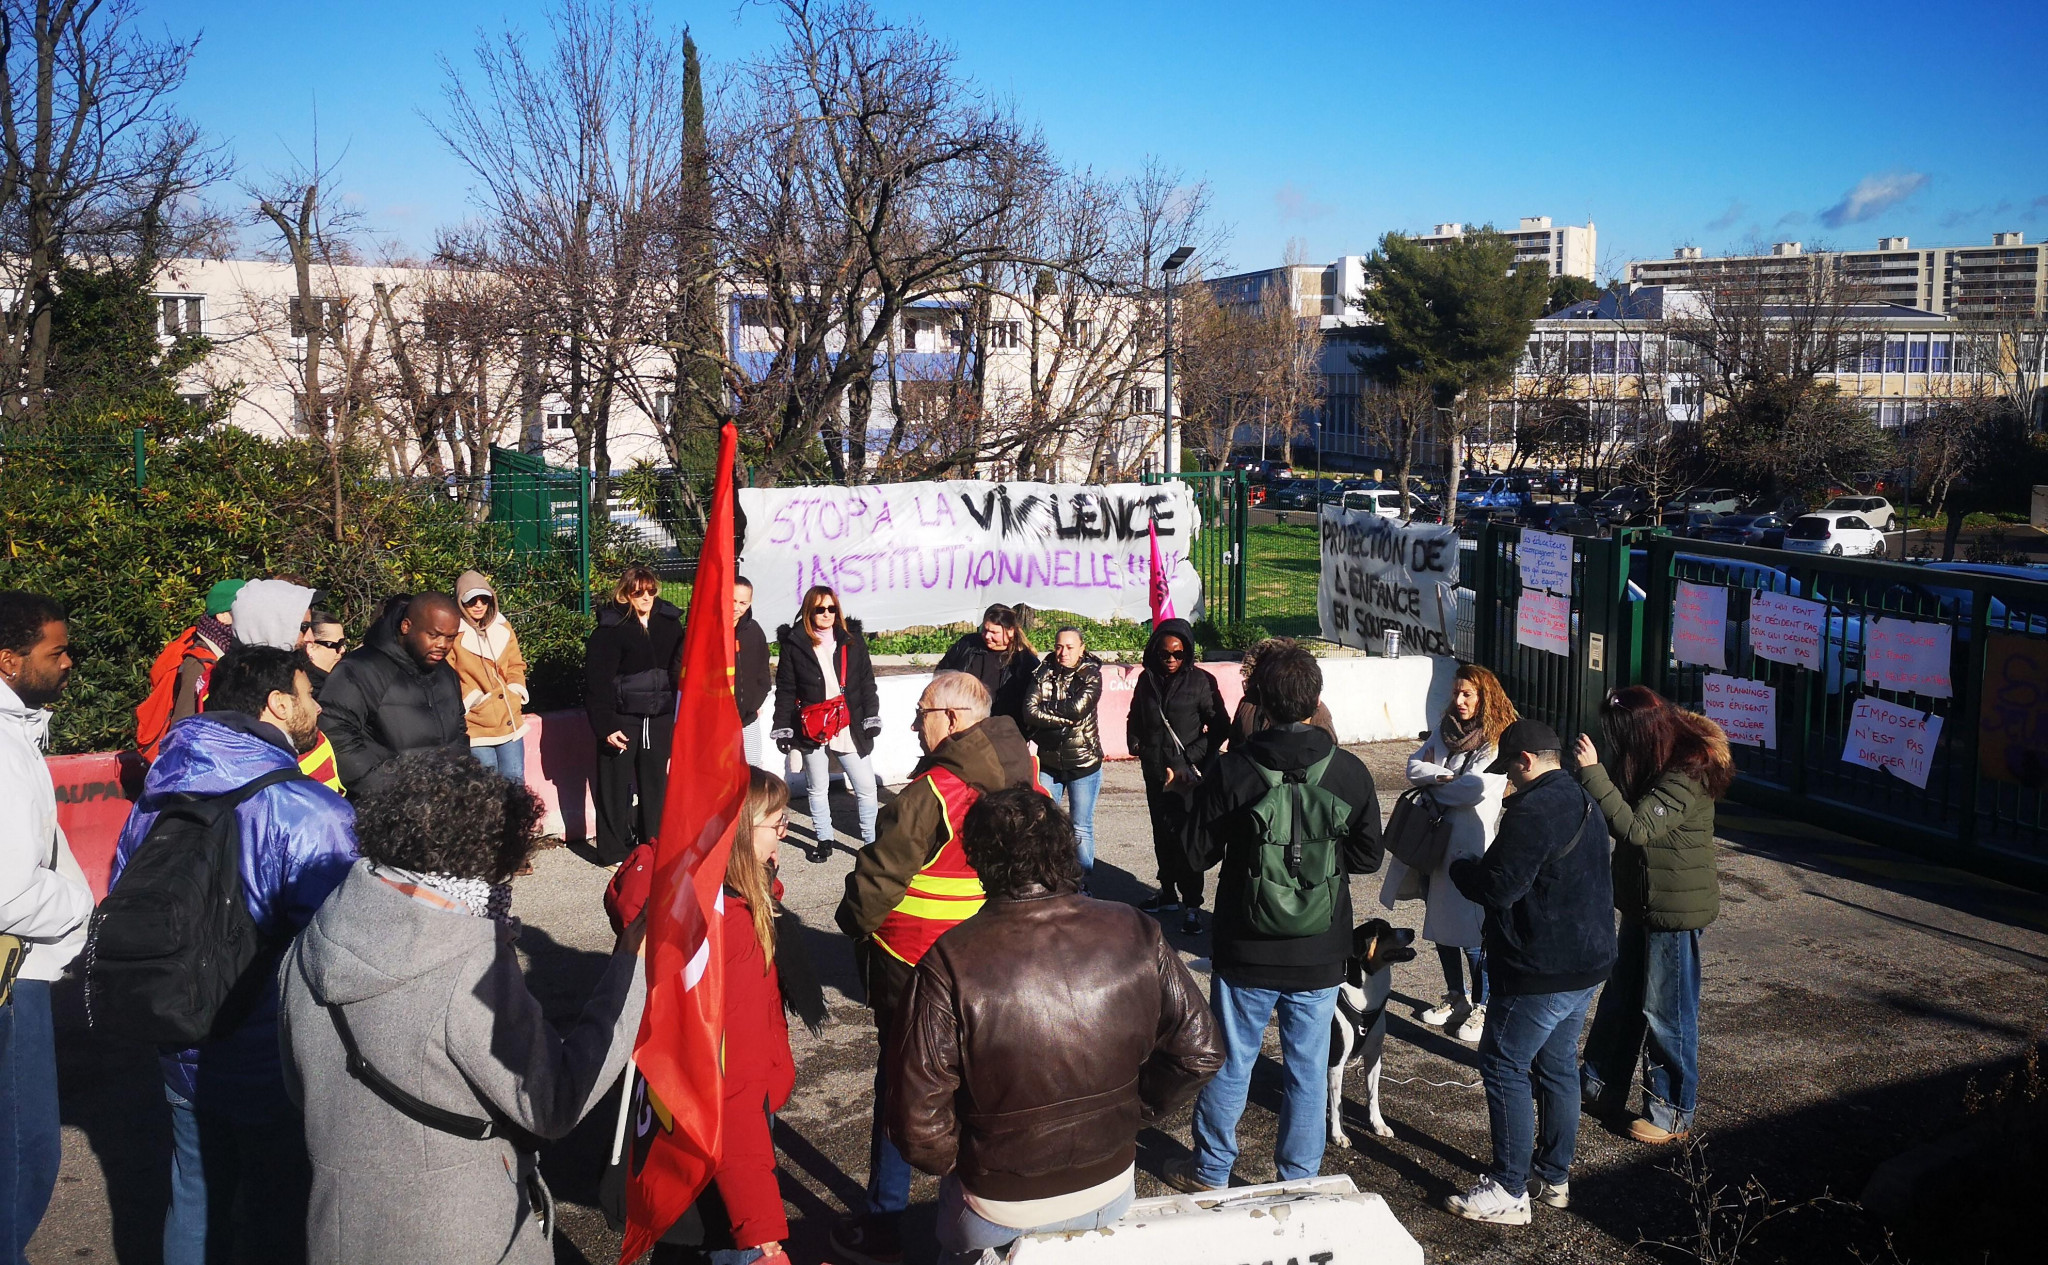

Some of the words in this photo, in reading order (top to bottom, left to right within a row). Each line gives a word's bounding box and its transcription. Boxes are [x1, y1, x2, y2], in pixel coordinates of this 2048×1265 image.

[771, 499, 867, 544] STOP
[914, 492, 956, 526] LA
[1322, 518, 1406, 566] PROTECTION
[1412, 538, 1447, 572] DE
[1335, 561, 1420, 619] L'ENFANCE
[1751, 598, 1771, 606] CEUX
[1774, 602, 1788, 611] QUI
[1792, 605, 1816, 616] FONT
[1333, 602, 1349, 631] EN
[1752, 614, 1761, 622] NE
[1765, 613, 1802, 629] DÉCIDENT
[1751, 627, 1766, 636] CEUX
[1768, 632, 1781, 640] QUI
[1783, 631, 1818, 646] DÉCIDENT
[1871, 629, 1889, 643] ON
[1896, 632, 1937, 647] TOUCHE
[1754, 641, 1762, 651] NE
[1766, 645, 1787, 655] FONT
[1794, 647, 1810, 658] PAS
[1869, 648, 1881, 660] LE
[1705, 682, 1720, 693] VOS
[1726, 684, 1770, 699] PLANNINGS
[1706, 699, 1725, 708] NOUS
[1709, 716, 1729, 727] OTRE
[1733, 717, 1765, 729] COLÈRE
[1857, 704, 1926, 731] IMPOSER
[1855, 726, 1896, 744] N'EST
[1907, 738, 1924, 755] PAS
[1858, 748, 1906, 770] DIRIGER
